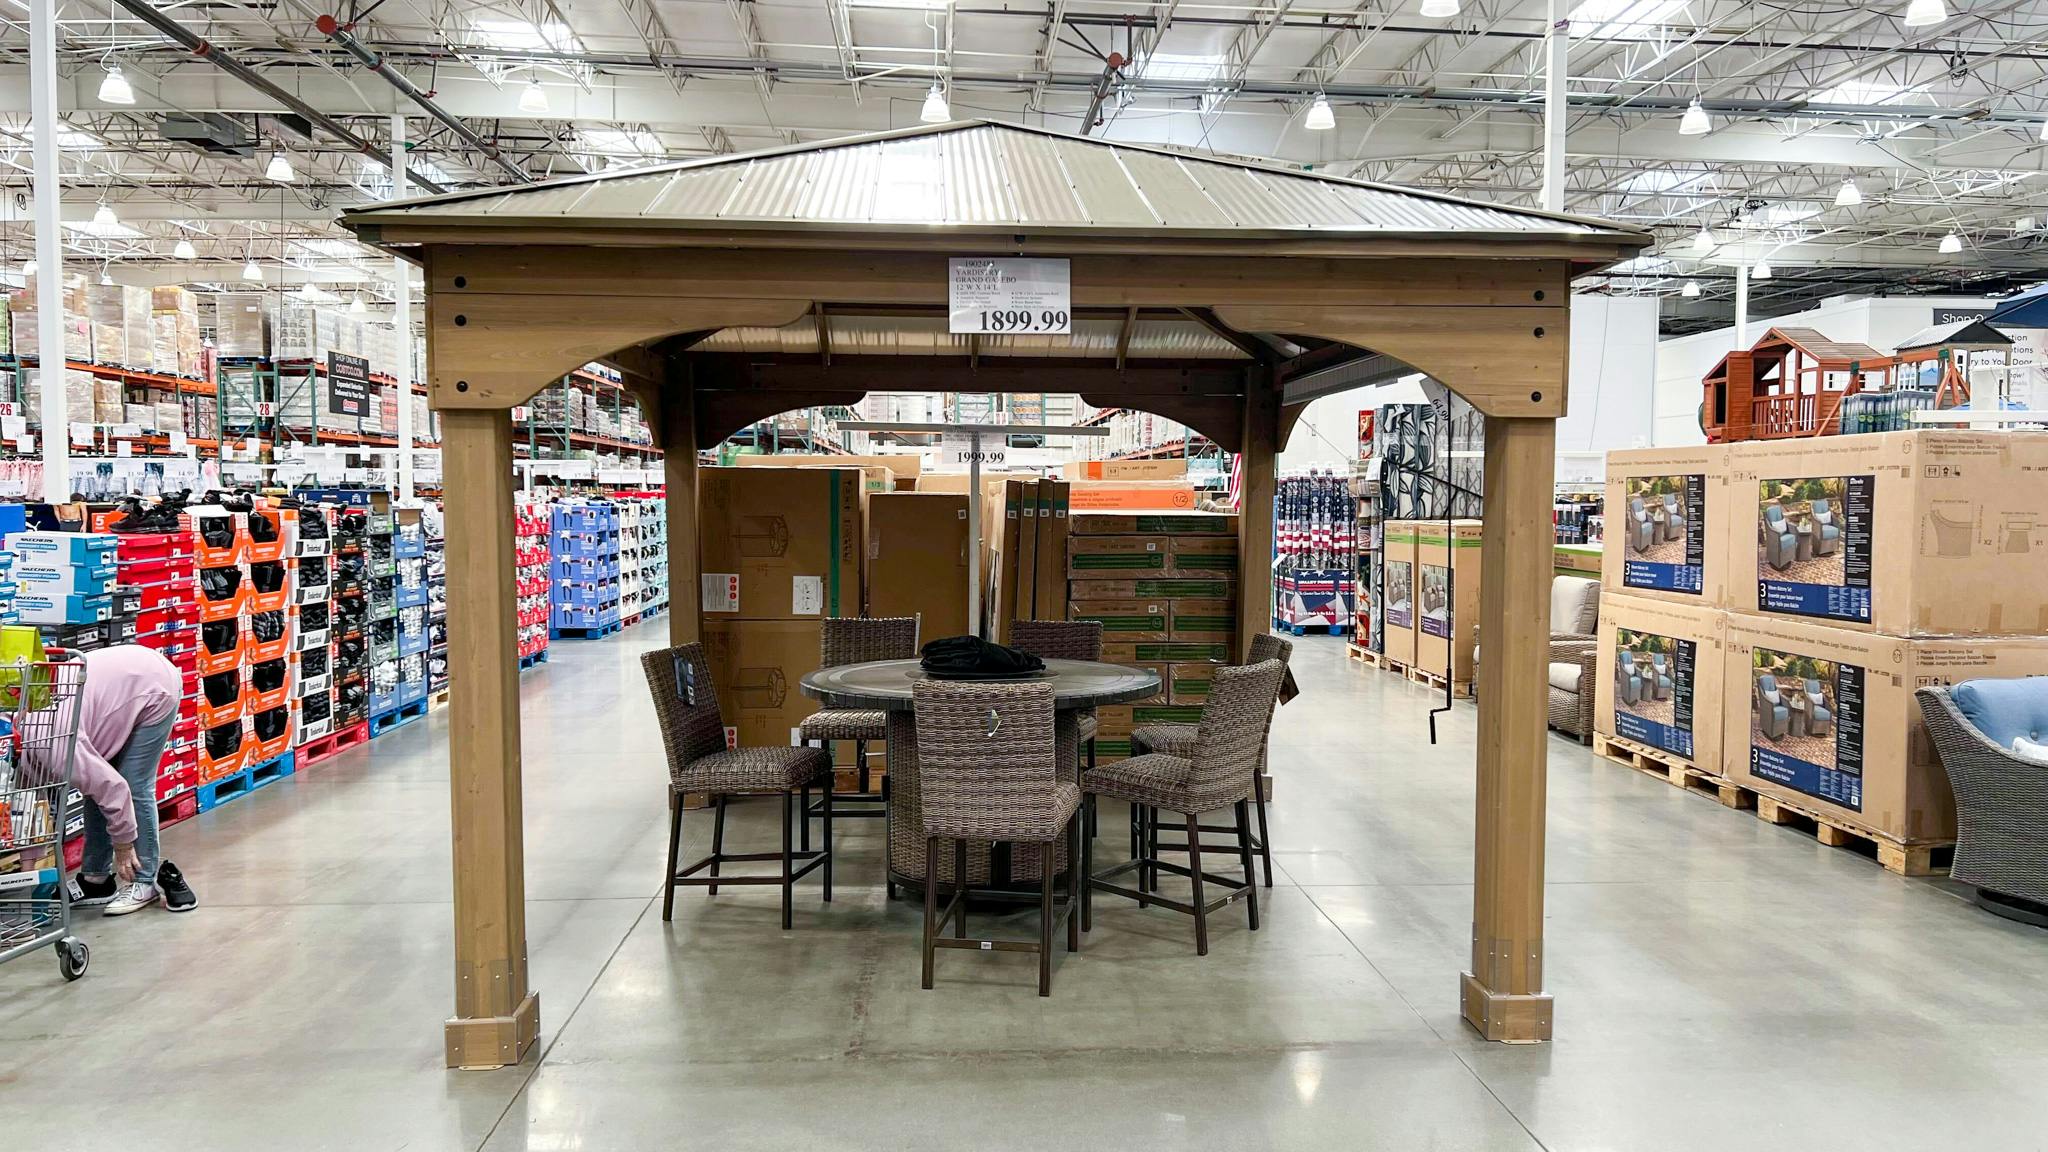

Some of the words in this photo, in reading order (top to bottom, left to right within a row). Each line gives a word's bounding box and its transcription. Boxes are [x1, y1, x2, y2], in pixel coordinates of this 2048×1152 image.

[979, 310, 1068, 331] 1899.99
[0, 403, 12, 416] 26
[259, 403, 271, 416] 28
[514, 408, 523, 419] 30
[957, 452, 1004, 463] 1999.99
[1175, 495, 1186, 503] 1/2
[95, 516, 105, 526] 5
[1625, 563, 1630, 575] 3
[1760, 583, 1767, 597] 3
[1616, 713, 1621, 726] 3
[1752, 748, 1758, 763] 3
